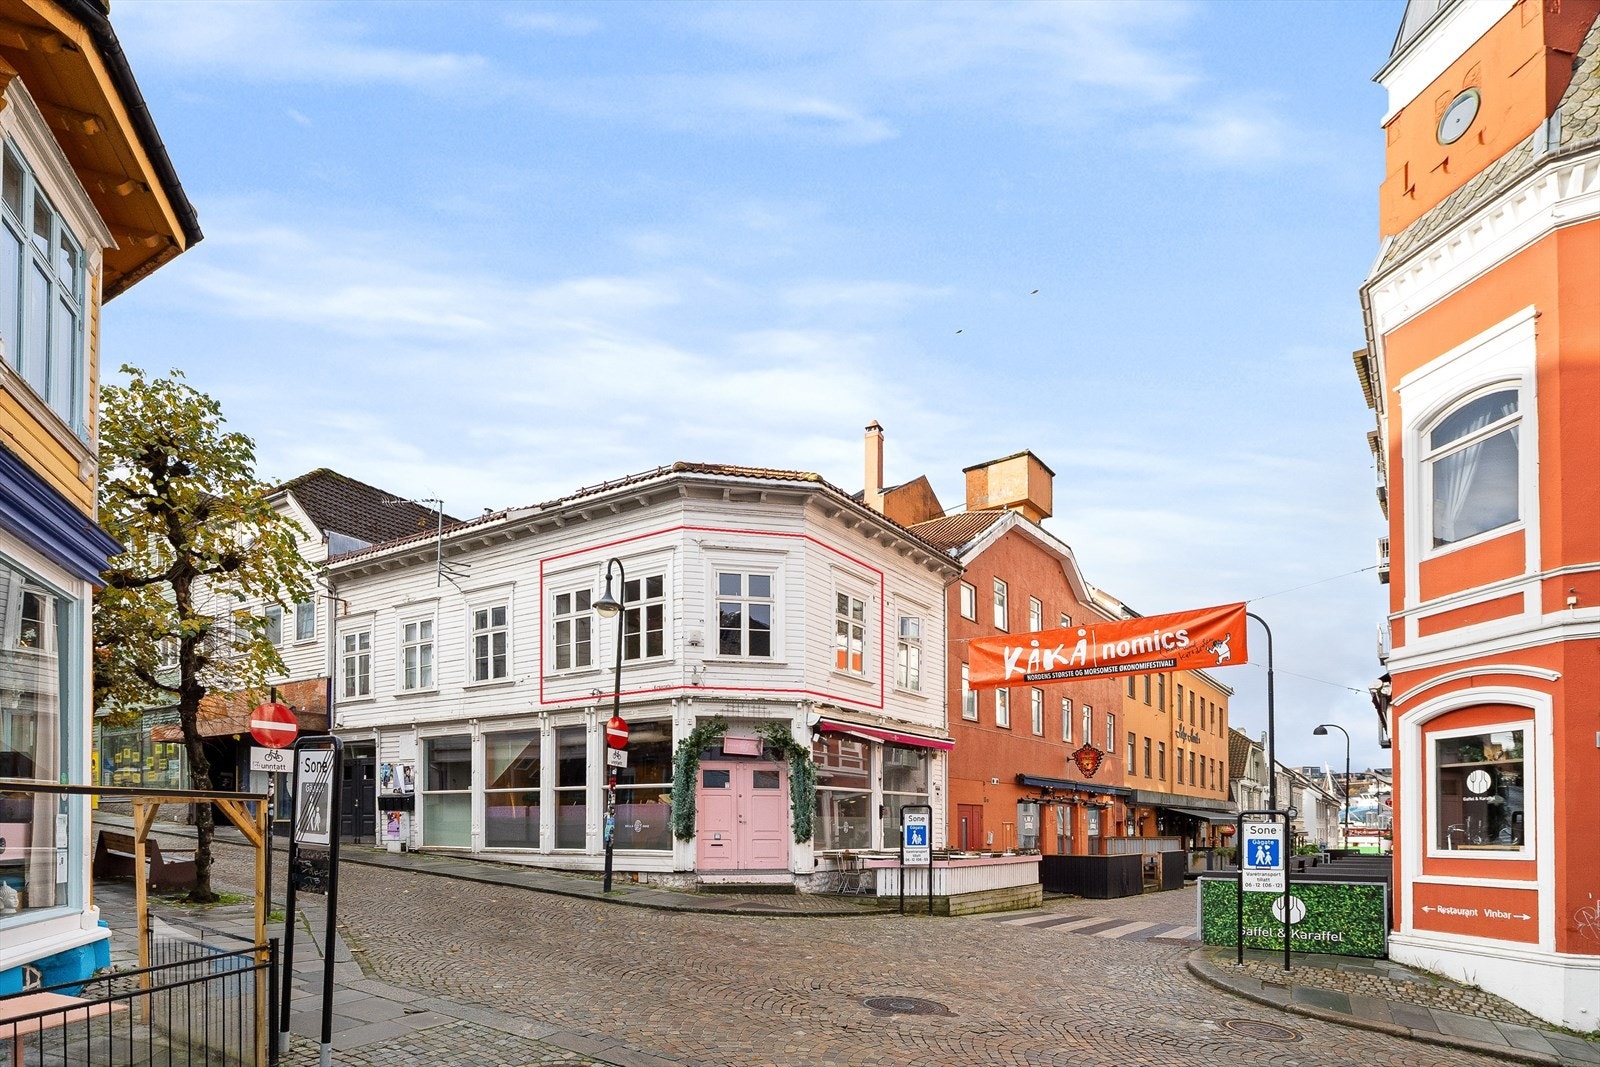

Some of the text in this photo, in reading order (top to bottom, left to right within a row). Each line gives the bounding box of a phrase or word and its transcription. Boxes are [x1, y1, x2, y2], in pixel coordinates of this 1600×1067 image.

[1003, 629, 1088, 681] KÅKÅ
[1102, 628, 1190, 660] nomics
[1026, 672, 1052, 681] NORDENS
[1052, 670, 1074, 678] STØRSTE
[1084, 665, 1118, 675] MORSOMSTE
[1119, 659, 1174, 672] ØKONOMIFESTIVAL!
[261, 763, 286, 771] unntatt
[305, 757, 328, 773] Sone
[1250, 825, 1277, 835] Sone
[1437, 905, 1511, 920] Restaurant Vinbar
[1277, 928, 1286, 938] &
[1291, 928, 1343, 942] Karaffel
